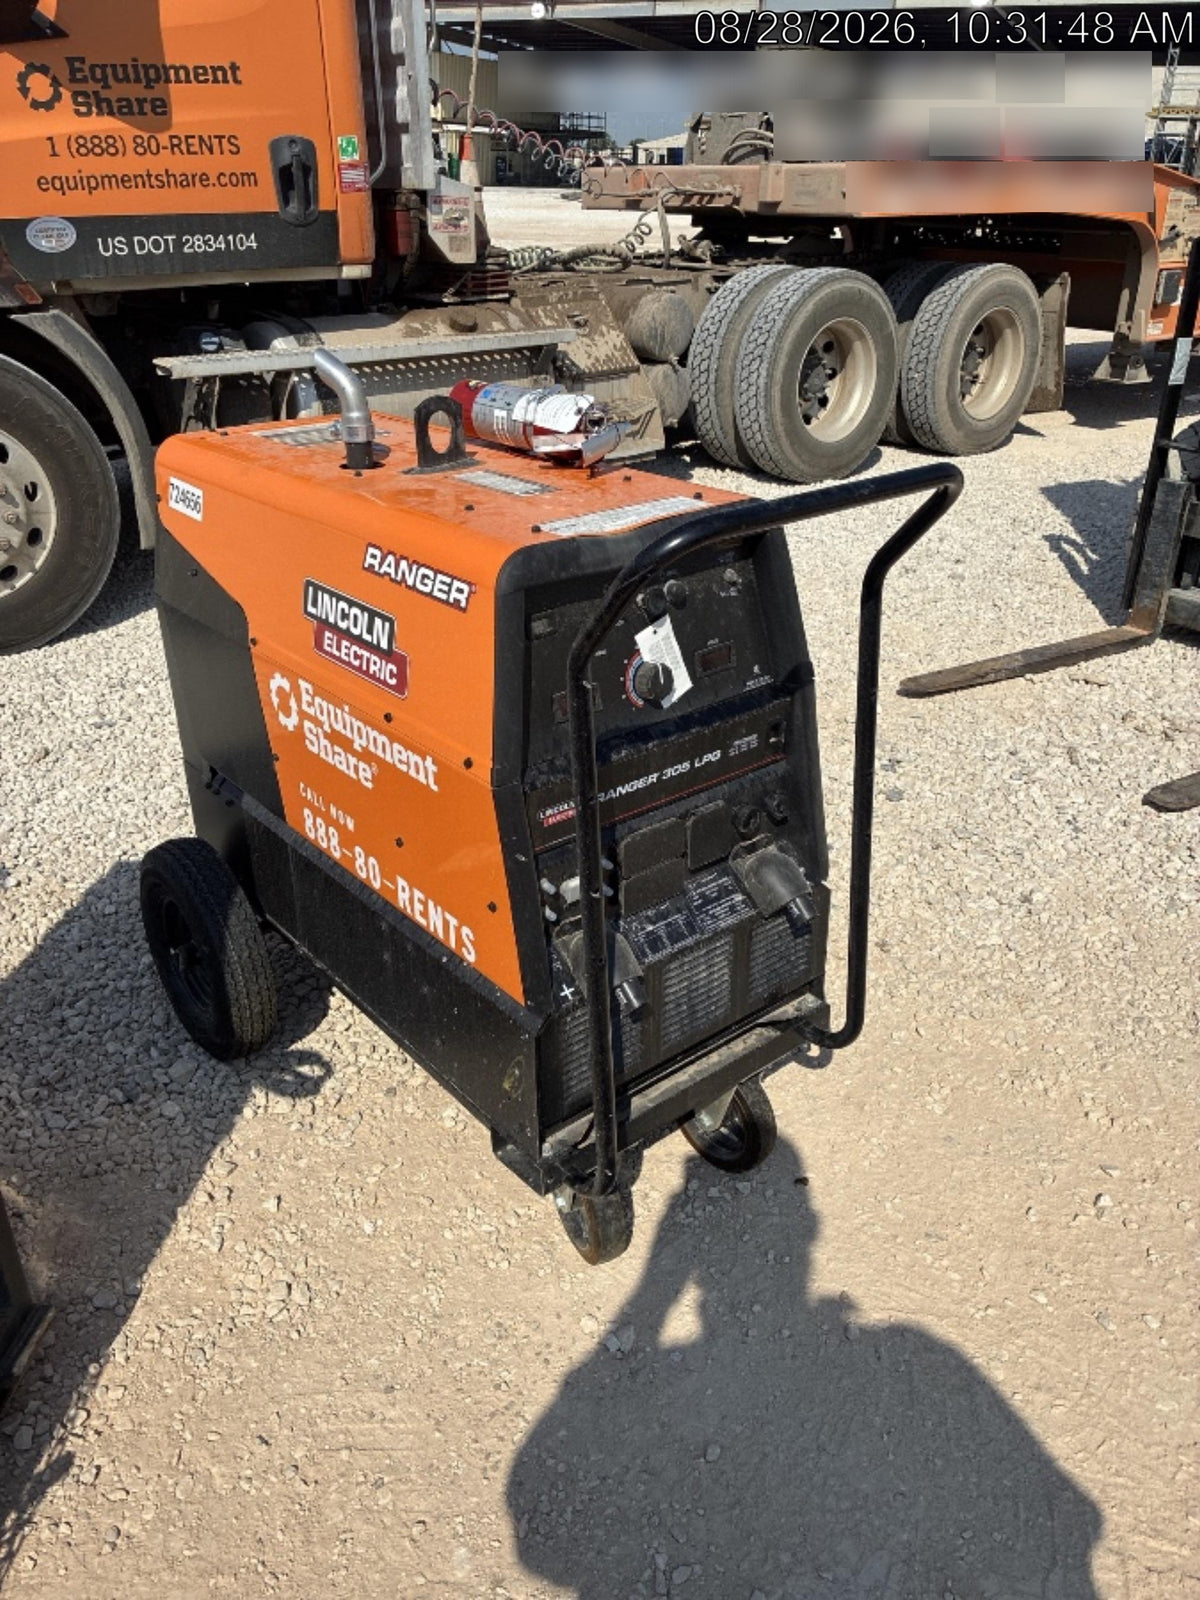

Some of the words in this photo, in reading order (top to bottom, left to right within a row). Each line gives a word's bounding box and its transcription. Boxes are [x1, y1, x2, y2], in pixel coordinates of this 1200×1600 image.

[65, 56, 242, 89] Equipment
[71, 90, 168, 118] Share
[46, 136, 60, 157] 1
[66, 134, 127, 158] (888)
[133, 134, 241, 157] 80-RENTS
[36, 168, 259, 196] equipmentshare.com
[97, 236, 129, 257] US
[133, 235, 177, 255] DOT
[182, 232, 258, 253] 2834104
[364, 546, 470, 609] RANGER
[306, 586, 390, 650] LINCOLN
[323, 630, 398, 686] ELECTRIC
[298, 678, 439, 792] Equipment
[661, 759, 691, 781] 305
[299, 781, 327, 812] CALL
[330, 804, 356, 833] NOW
[302, 807, 477, 964] 888-80-RENTS
